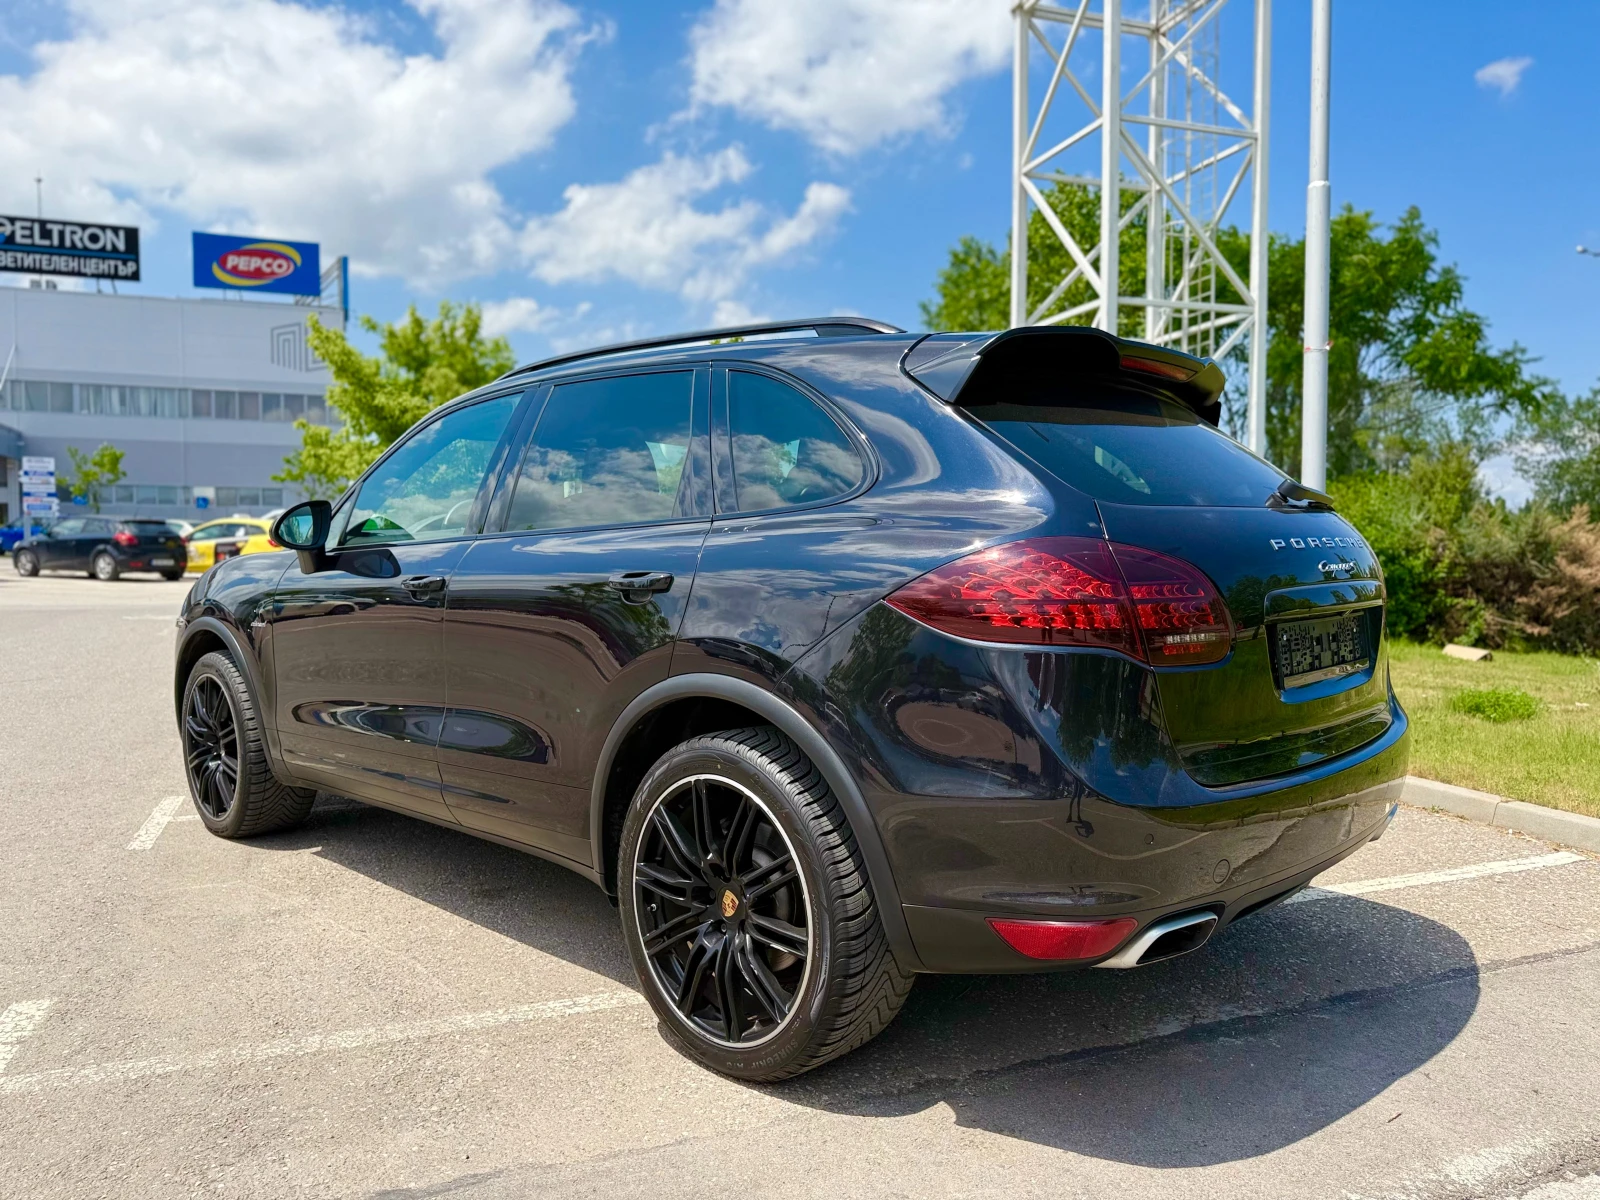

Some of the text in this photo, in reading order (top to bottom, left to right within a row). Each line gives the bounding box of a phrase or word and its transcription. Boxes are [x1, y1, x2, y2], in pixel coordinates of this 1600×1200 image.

[80, 257, 137, 277] ЦЕНТЪР
[226, 254, 288, 274] PEPCO
[1269, 537, 1364, 551] PORSCHE
